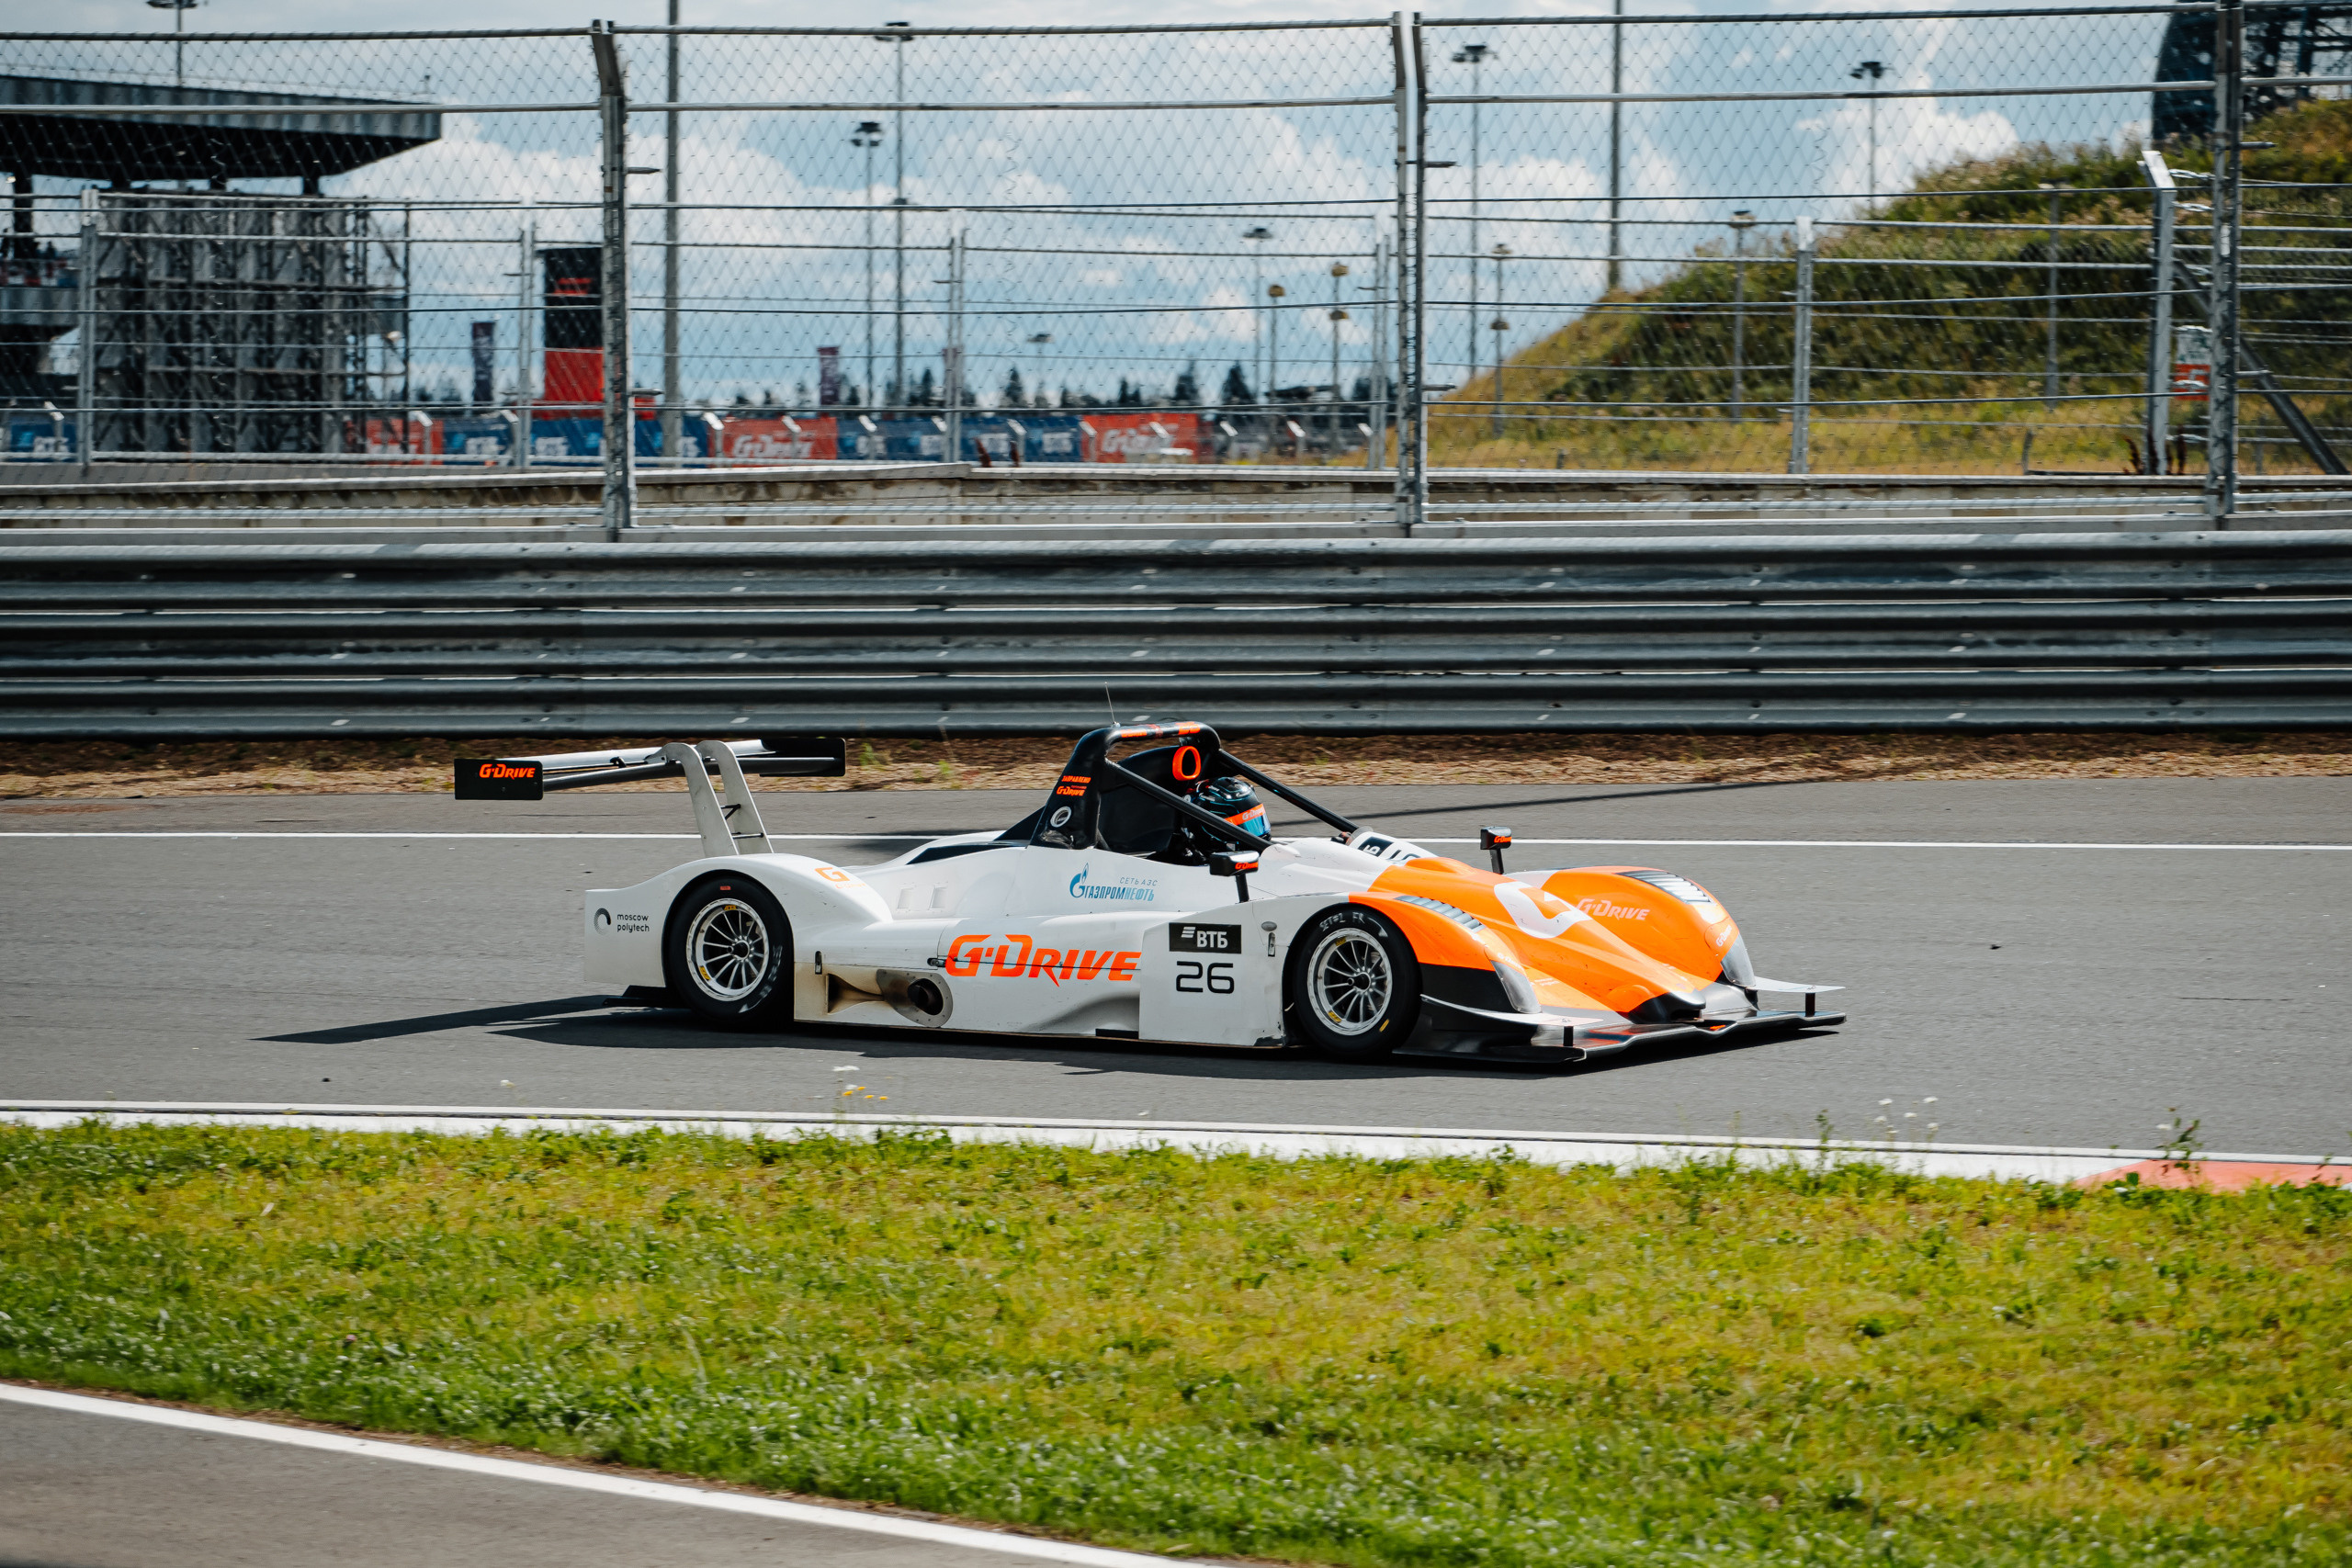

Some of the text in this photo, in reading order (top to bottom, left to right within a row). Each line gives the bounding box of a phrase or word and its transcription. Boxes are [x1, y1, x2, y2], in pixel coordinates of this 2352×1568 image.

[479, 763, 536, 780] G-DRIVE
[1084, 885, 1155, 901] ГАЗПРОМНЕФТЬ
[1576, 898, 1650, 920] G-DRIVE
[616, 923, 650, 933] polytech
[1196, 929, 1228, 949] ВТБ
[944, 934, 1141, 987] G-DRIVE
[1175, 961, 1235, 994] 26
